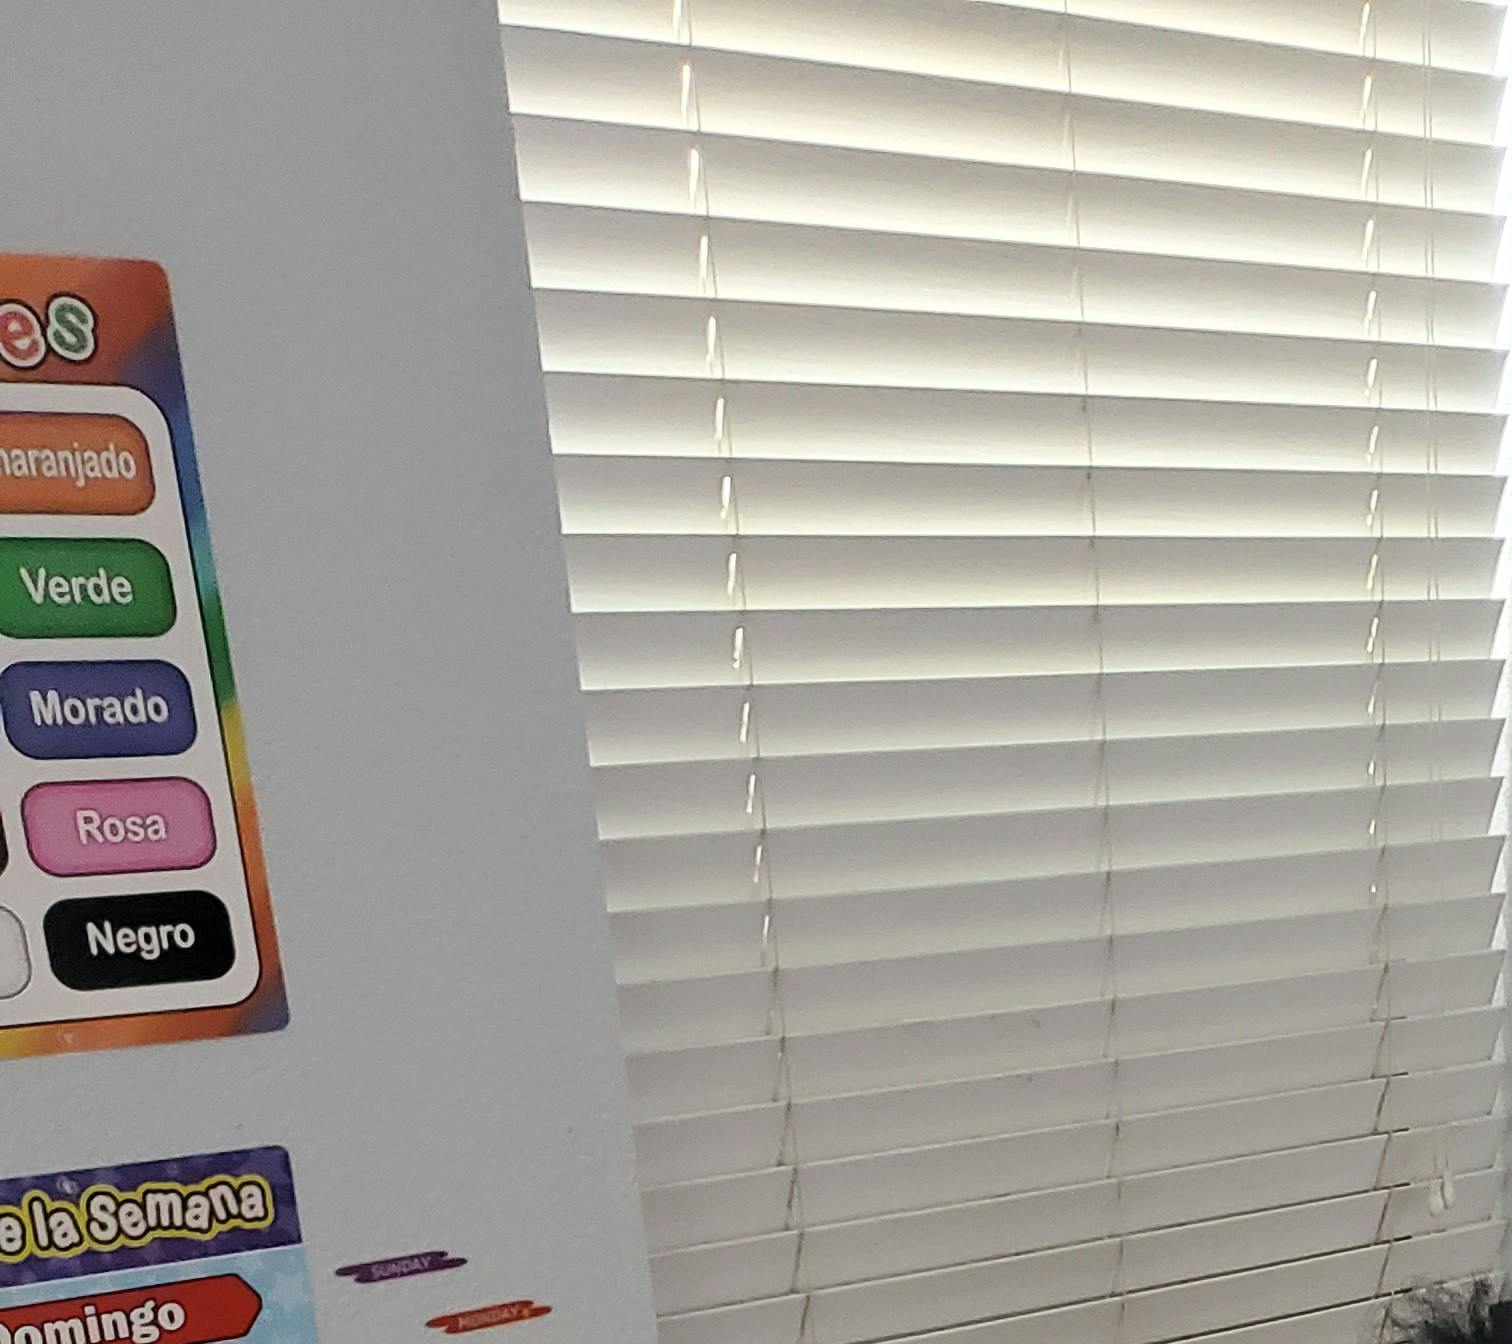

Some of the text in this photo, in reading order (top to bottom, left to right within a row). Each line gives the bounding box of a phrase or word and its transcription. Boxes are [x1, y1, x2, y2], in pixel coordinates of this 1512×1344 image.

[20, 566, 134, 605] Verde
[30, 690, 169, 729] Morado
[75, 809, 167, 845] Rosa
[85, 920, 195, 960] Negro
[30, 1198, 81, 1248] la
[88, 1181, 266, 1241] Semana
[371, 1256, 431, 1279] SUNDAY
